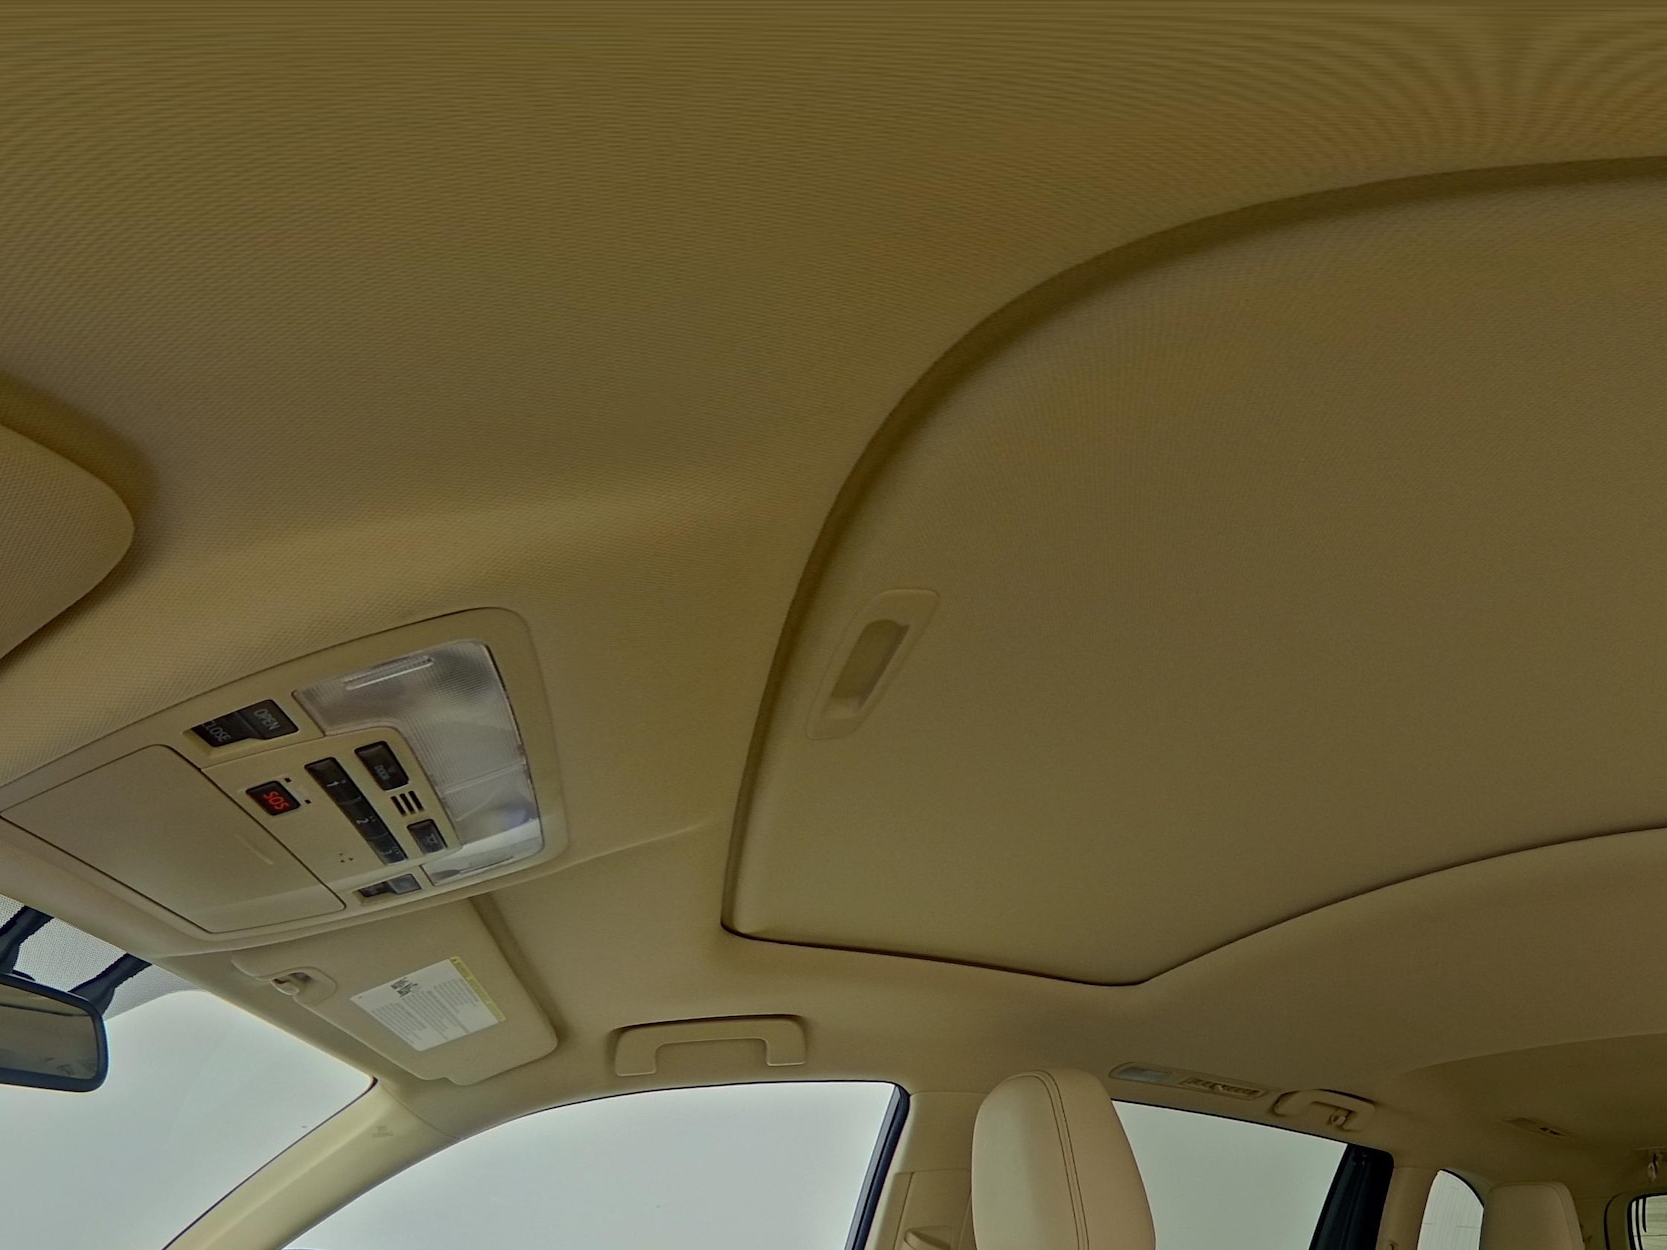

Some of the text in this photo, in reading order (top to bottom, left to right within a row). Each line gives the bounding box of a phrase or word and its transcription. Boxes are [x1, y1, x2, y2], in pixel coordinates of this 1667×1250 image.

[253, 708, 280, 730] OPEN
[203, 721, 231, 742] LOSE
[263, 791, 289, 810] SOS
